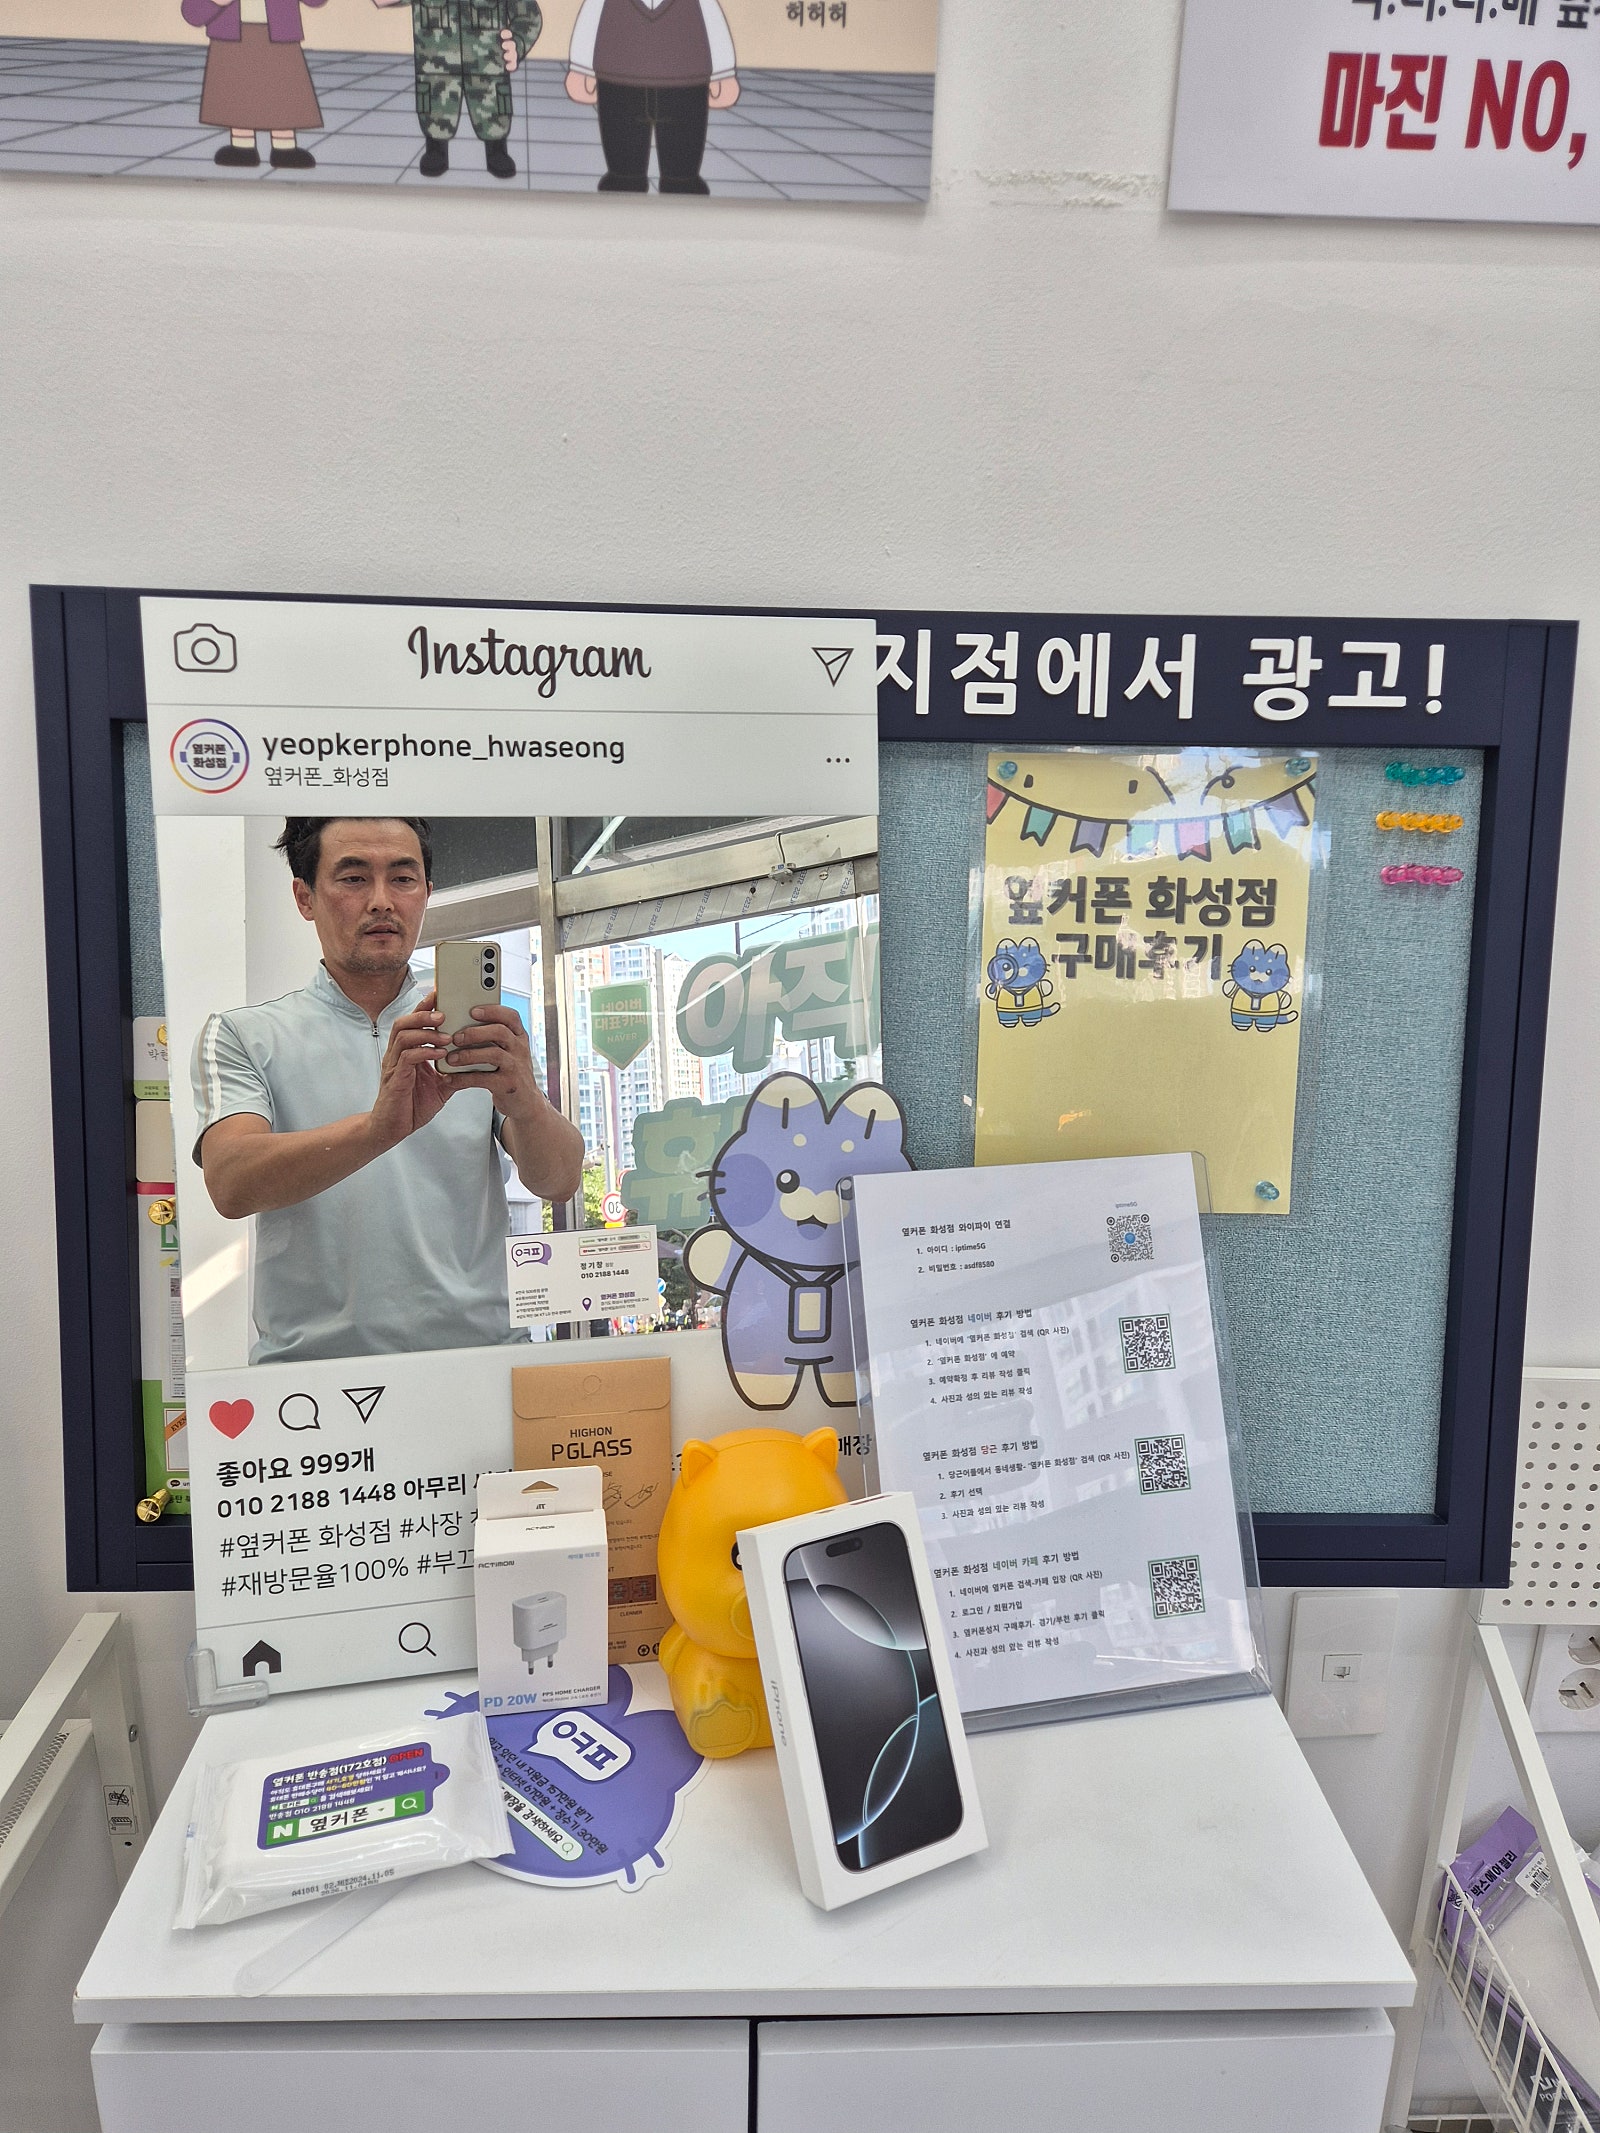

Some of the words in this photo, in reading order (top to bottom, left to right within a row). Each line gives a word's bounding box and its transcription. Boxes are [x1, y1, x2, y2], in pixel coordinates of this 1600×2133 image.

[786, 0, 847, 28] 허허허
[1318, 51, 1448, 151] 마진
[1464, 58, 1588, 170] NO,
[407, 624, 652, 698] Instagram
[877, 628, 1197, 720] 지점에서
[1242, 635, 1446, 722] 광고!
[262, 732, 626, 764] yeopkerphone_hwaseong
[193, 757, 228, 769] 화성점
[264, 766, 390, 788] 옆커폰_화성점
[1004, 875, 1133, 925] 옆커폰
[1145, 875, 1278, 928] 화성점
[1051, 930, 1224, 981] 구매후기
[607, 1032, 638, 1043] NAVER
[901, 1227, 926, 1237] 옆커폰
[930, 1224, 955, 1234] 화성점
[958, 1220, 991, 1231] 와이파이
[994, 1219, 1011, 1229] 연결
[926, 1244, 948, 1254] 아이디
[928, 1263, 957, 1273] 비밀번호
[910, 1317, 935, 1328] 옆커폰
[938, 1314, 964, 1326] 화성점
[967, 1311, 993, 1323] 네이버
[996, 1310, 1013, 1321] 후기
[1016, 1308, 1033, 1318] 방법
[935, 1335, 964, 1346] 네이버에
[1020, 1329, 1034, 1338] 검색
[1052, 1325, 1070, 1335] 사진)
[1001, 1349, 1015, 1359] 예약
[939, 1373, 968, 1384] 예약확정
[971, 1372, 979, 1382] 후
[981, 1370, 996, 1380] 리뷰
[998, 1368, 1013, 1378] 작성
[1016, 1367, 1031, 1376] 클릭
[941, 1393, 963, 1404] 사진과
[966, 1391, 981, 1401] 성의
[983, 1390, 998, 1399] 있는
[1001, 1388, 1015, 1397] 리뷰
[1018, 1386, 1033, 1395] 작성
[569, 1426, 613, 1438] HIGHON
[922, 1449, 948, 1461] 옆커폰
[951, 1446, 977, 1458] 화성점
[980, 1444, 998, 1455] 당근
[1001, 1441, 1018, 1452] 후기
[1022, 1440, 1038, 1450] 방법
[1081, 1454, 1095, 1464] 검색
[1113, 1450, 1131, 1460] 사진)
[216, 1457, 292, 1487] 좋아요
[300, 1447, 375, 1476] 999개
[217, 1499, 263, 1519] 010
[270, 1489, 331, 1514] 2188
[339, 1482, 397, 1505] 1448
[403, 1473, 467, 1500] 아무리
[950, 1489, 965, 1499] 후기
[968, 1487, 983, 1497] 선택
[952, 1508, 974, 1519] 사진과
[977, 1505, 992, 1516] 성의
[995, 1504, 1010, 1514] 있는
[1012, 1502, 1028, 1512] 리뷰
[1030, 1500, 1045, 1509] 작성
[220, 1527, 312, 1559] #옆커폰
[318, 1517, 391, 1549] 화성점
[399, 1510, 463, 1539] #사장
[933, 1566, 959, 1578] 옆커폰
[963, 1562, 988, 1574] 화성점
[992, 1558, 1018, 1570] 네이버
[1022, 1556, 1039, 1567] 카페
[1042, 1553, 1059, 1564] 후기
[1062, 1551, 1080, 1561] 방법
[221, 1556, 410, 1597] #재방문율100%
[960, 1585, 989, 1596] 네이버에
[992, 1581, 1014, 1592] 옆커폰
[1052, 1575, 1066, 1585] 입장
[1086, 1570, 1103, 1580] 사진)
[961, 1606, 983, 1616] 로그인
[993, 1600, 1023, 1612] 회원가입
[1073, 1611, 1088, 1621] 후기
[1091, 1609, 1105, 1619] 클릭
[965, 1646, 987, 1657] 사진과
[990, 1643, 1006, 1654] 성의
[1008, 1642, 1023, 1652] 있는
[1027, 1639, 1041, 1648] 리뷰
[1045, 1637, 1060, 1646] 작성
[573, 1685, 601, 1693] CHARGER
[484, 1697, 503, 1708] PD
[507, 1693, 537, 1706] 20W
[770, 1680, 788, 1747] iPhone
[272, 1773, 305, 1787] 옆커폰
[389, 1748, 424, 1763] OPEN
[515, 1760, 527, 1770] 내
[524, 1766, 550, 1788] 지원금
[573, 1805, 595, 1823] 받기
[294, 1807, 310, 1815] 010
[501, 1766, 526, 1789] 인터넷
[554, 1807, 581, 1831] 정수기
[576, 1828, 609, 1855] 30만원
[272, 1823, 294, 1841] N
[310, 1806, 369, 1833] 옆커폰
[522, 1808, 563, 1844] 검색하세요
